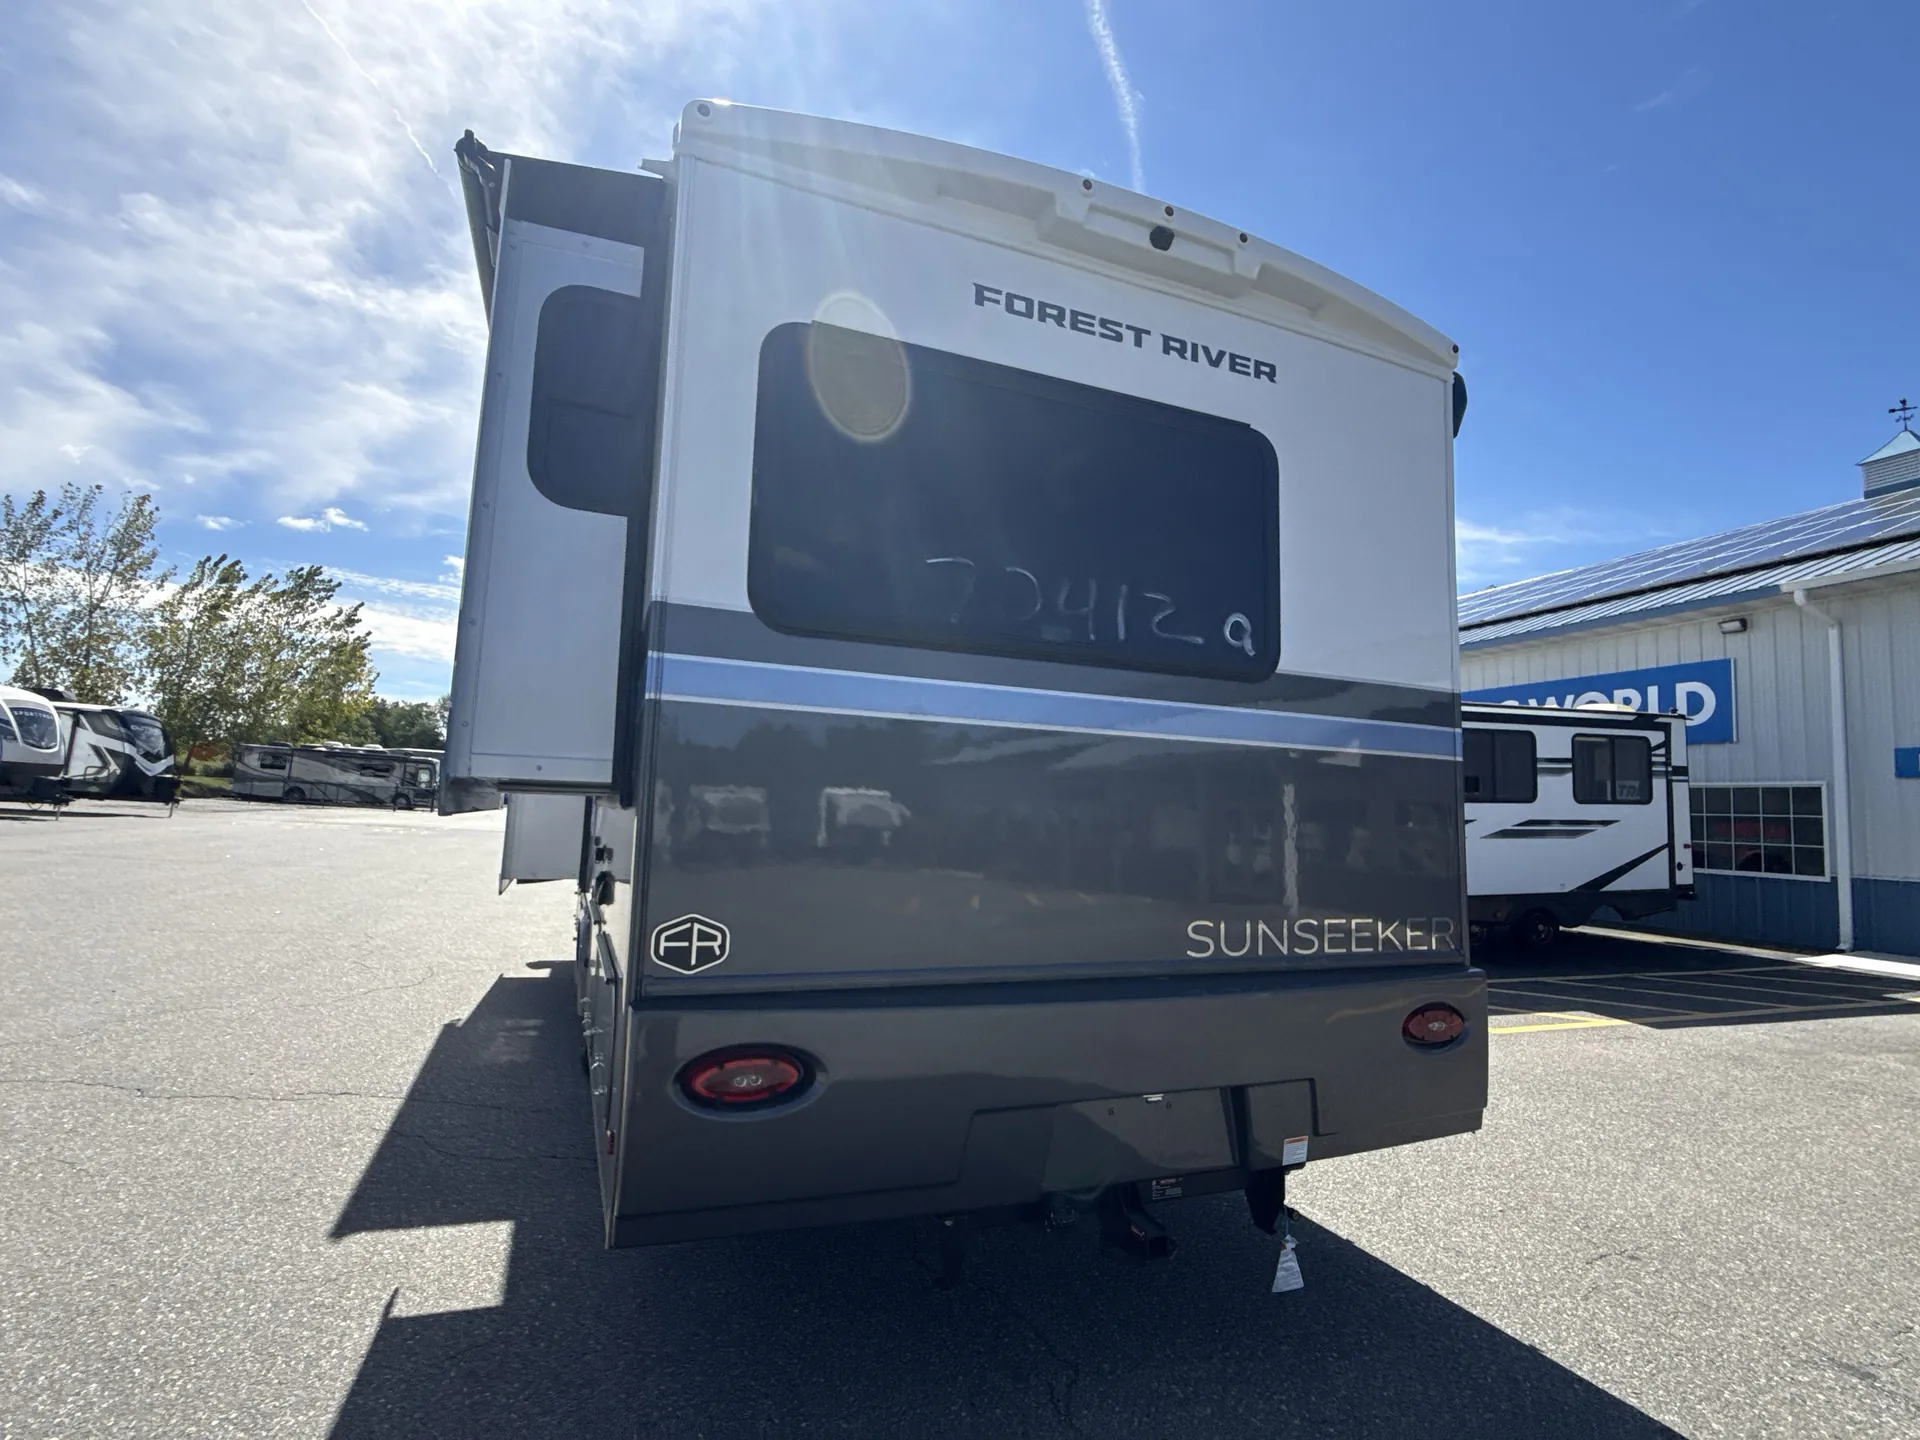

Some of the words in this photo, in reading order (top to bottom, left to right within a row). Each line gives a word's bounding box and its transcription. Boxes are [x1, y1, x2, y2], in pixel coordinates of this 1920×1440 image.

[972, 282, 1151, 350] FOREST
[1160, 333, 1278, 384] RIVER
[1186, 917, 1456, 958] SUNSEEKER
